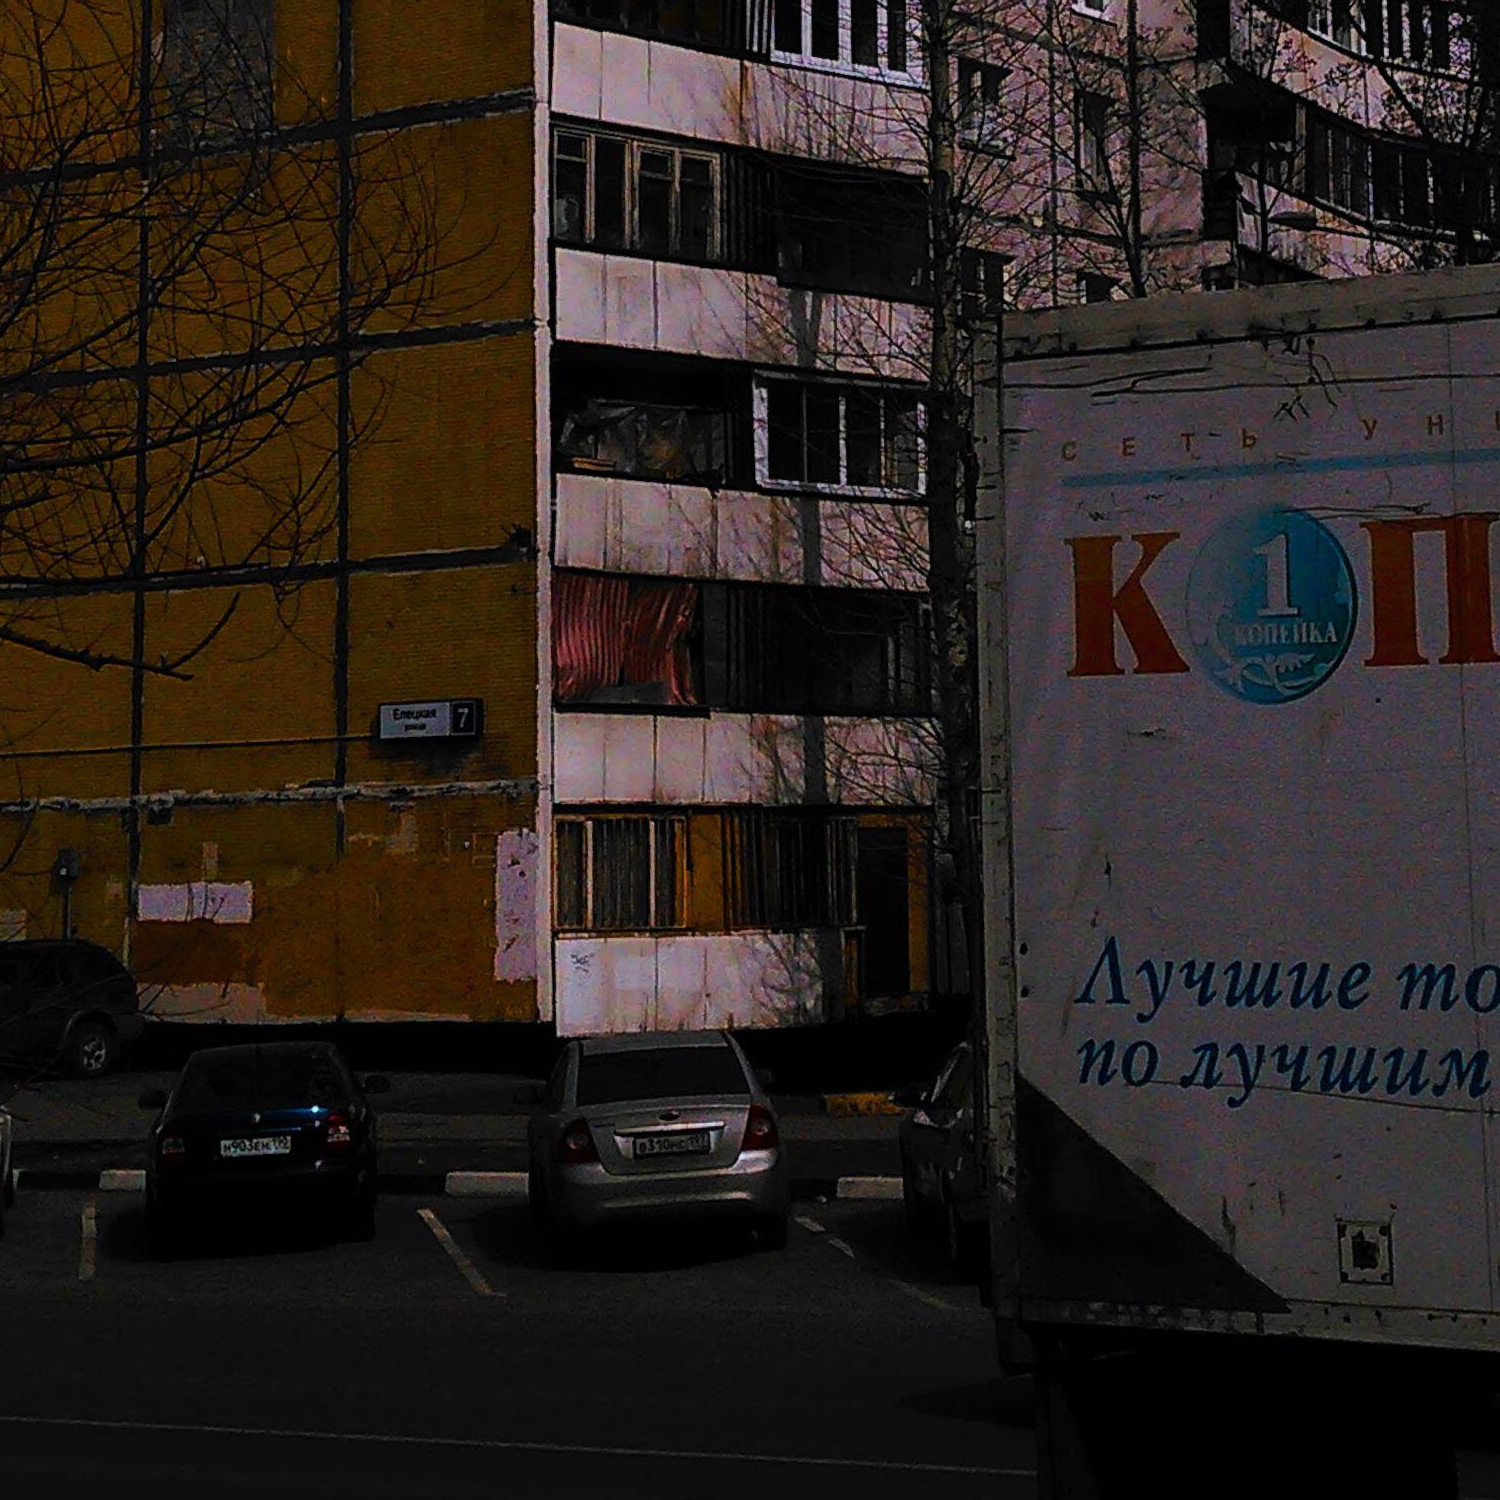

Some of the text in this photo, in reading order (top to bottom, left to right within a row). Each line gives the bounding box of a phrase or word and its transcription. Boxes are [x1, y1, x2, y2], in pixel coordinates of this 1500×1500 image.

[1061, 409, 1500, 462] СЕТЬ УН
[456, 706, 470, 729] 7
[1074, 936, 1500, 1024] Лучшие то
[1077, 1038, 1492, 1109] по лучшим
